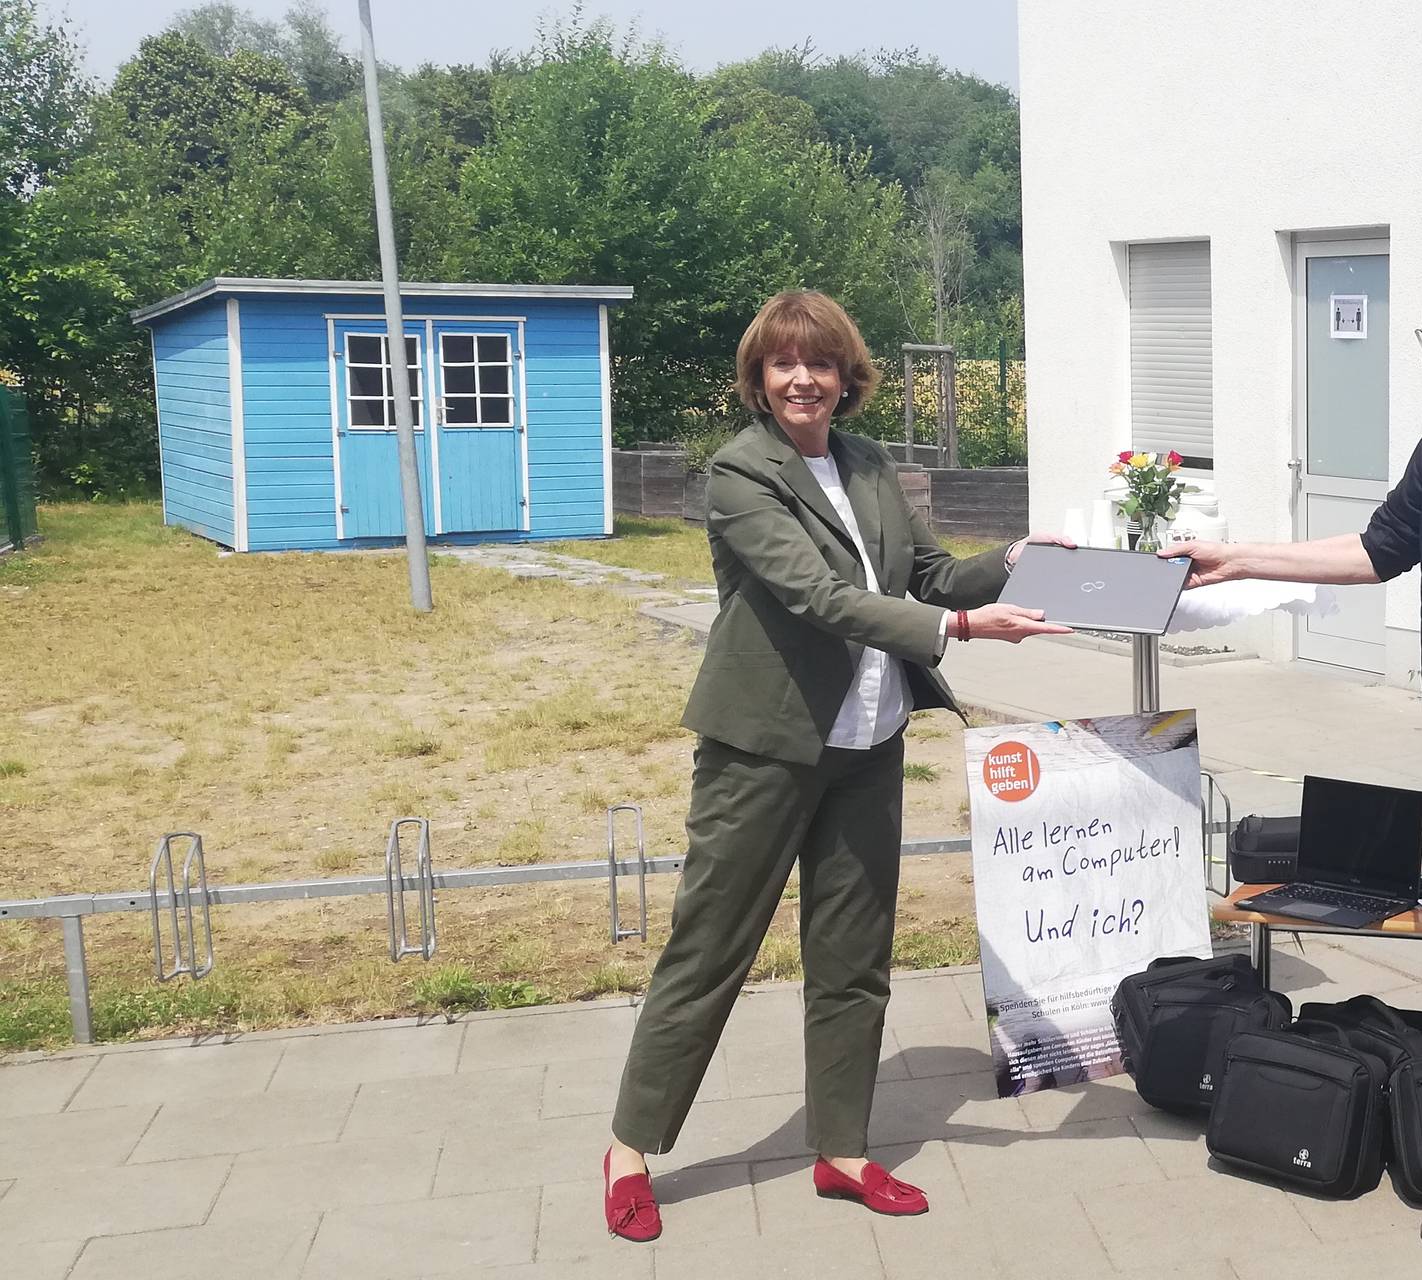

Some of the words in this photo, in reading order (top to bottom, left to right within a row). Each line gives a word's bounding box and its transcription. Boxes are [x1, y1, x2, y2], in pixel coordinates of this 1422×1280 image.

[988, 752, 1022, 765] kunst
[990, 767, 1016, 778] hilft
[991, 778, 1029, 794] geben
[993, 826, 1033, 856] Alle
[1043, 818, 1112, 848] lernen
[1022, 865, 1053, 882] am
[1062, 826, 1180, 876] Computer!
[1025, 904, 1079, 943] Und
[1091, 899, 1144, 938] ich?
[1000, 1000, 1033, 1012] Spenden
[1034, 998, 1046, 1006] Sie
[1031, 1008, 1061, 1018] Schulen
[1062, 1005, 1070, 1013] in
[1293, 1156, 1311, 1168] terra
